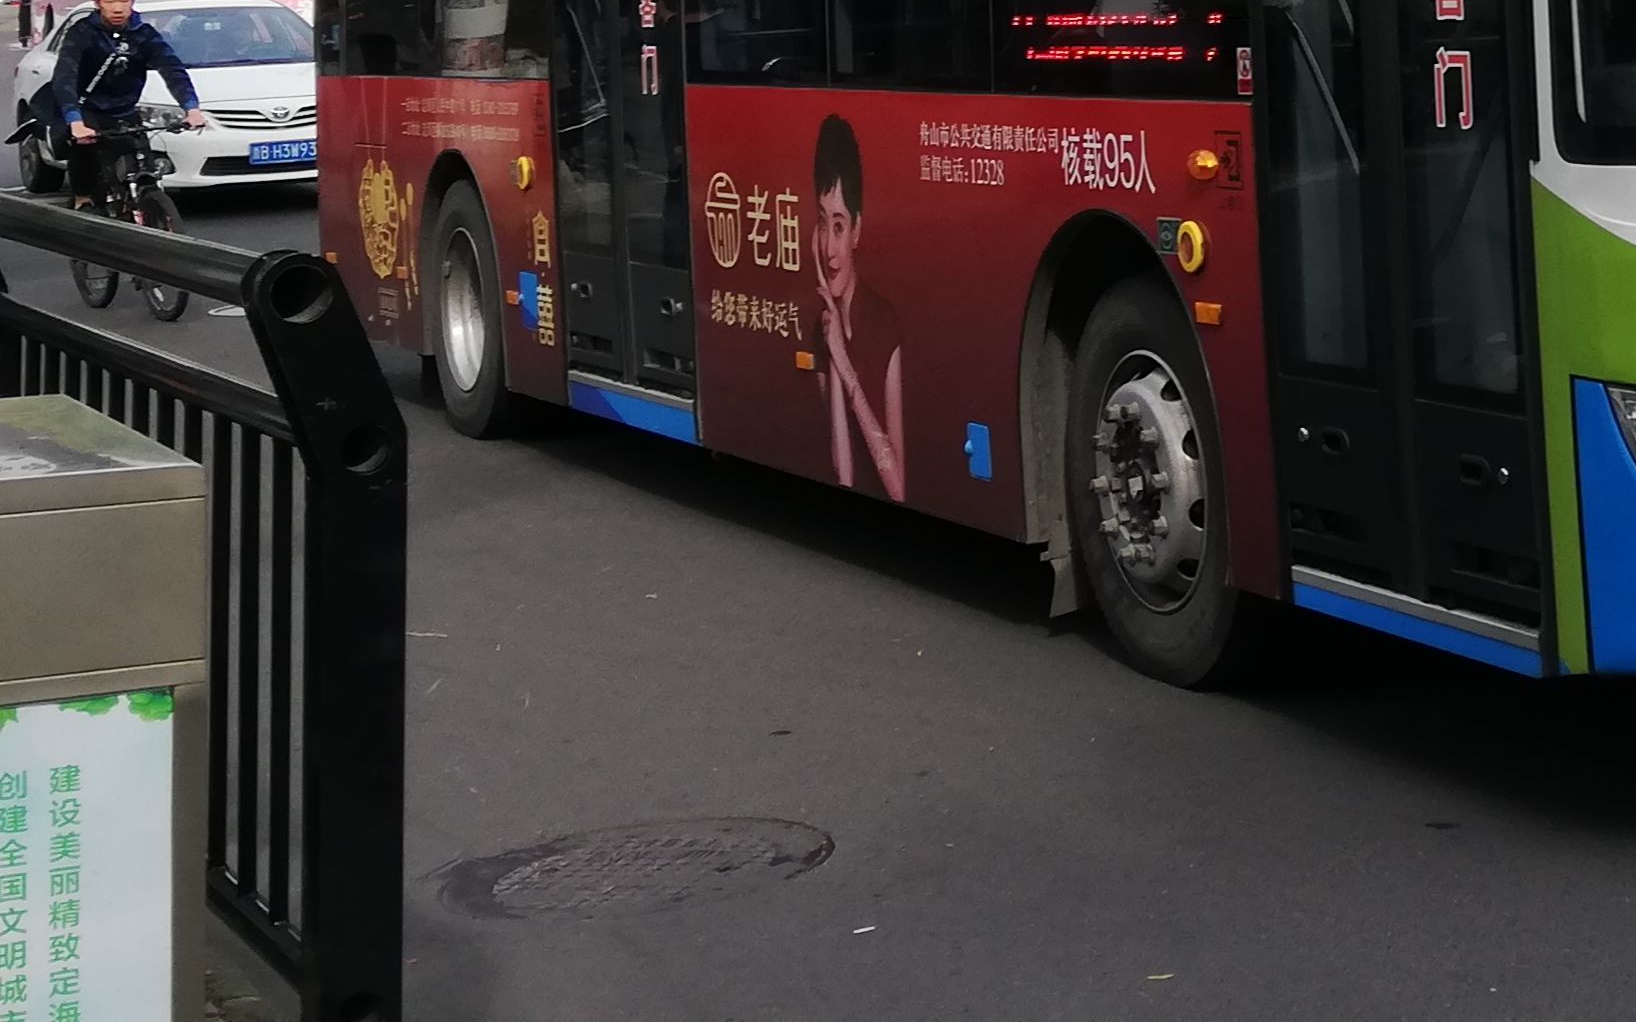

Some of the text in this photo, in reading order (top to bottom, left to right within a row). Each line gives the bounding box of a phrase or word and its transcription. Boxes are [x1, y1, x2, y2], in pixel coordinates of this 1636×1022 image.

[920, 120, 1059, 154] 舟山市公共交通有限责任公司
[1061, 127, 1156, 194] 核载95人
[746, 184, 801, 272] 老庙
[711, 288, 803, 341] 给您带来好运气
[48, 764, 81, 1022] 建设美丽精致定海
